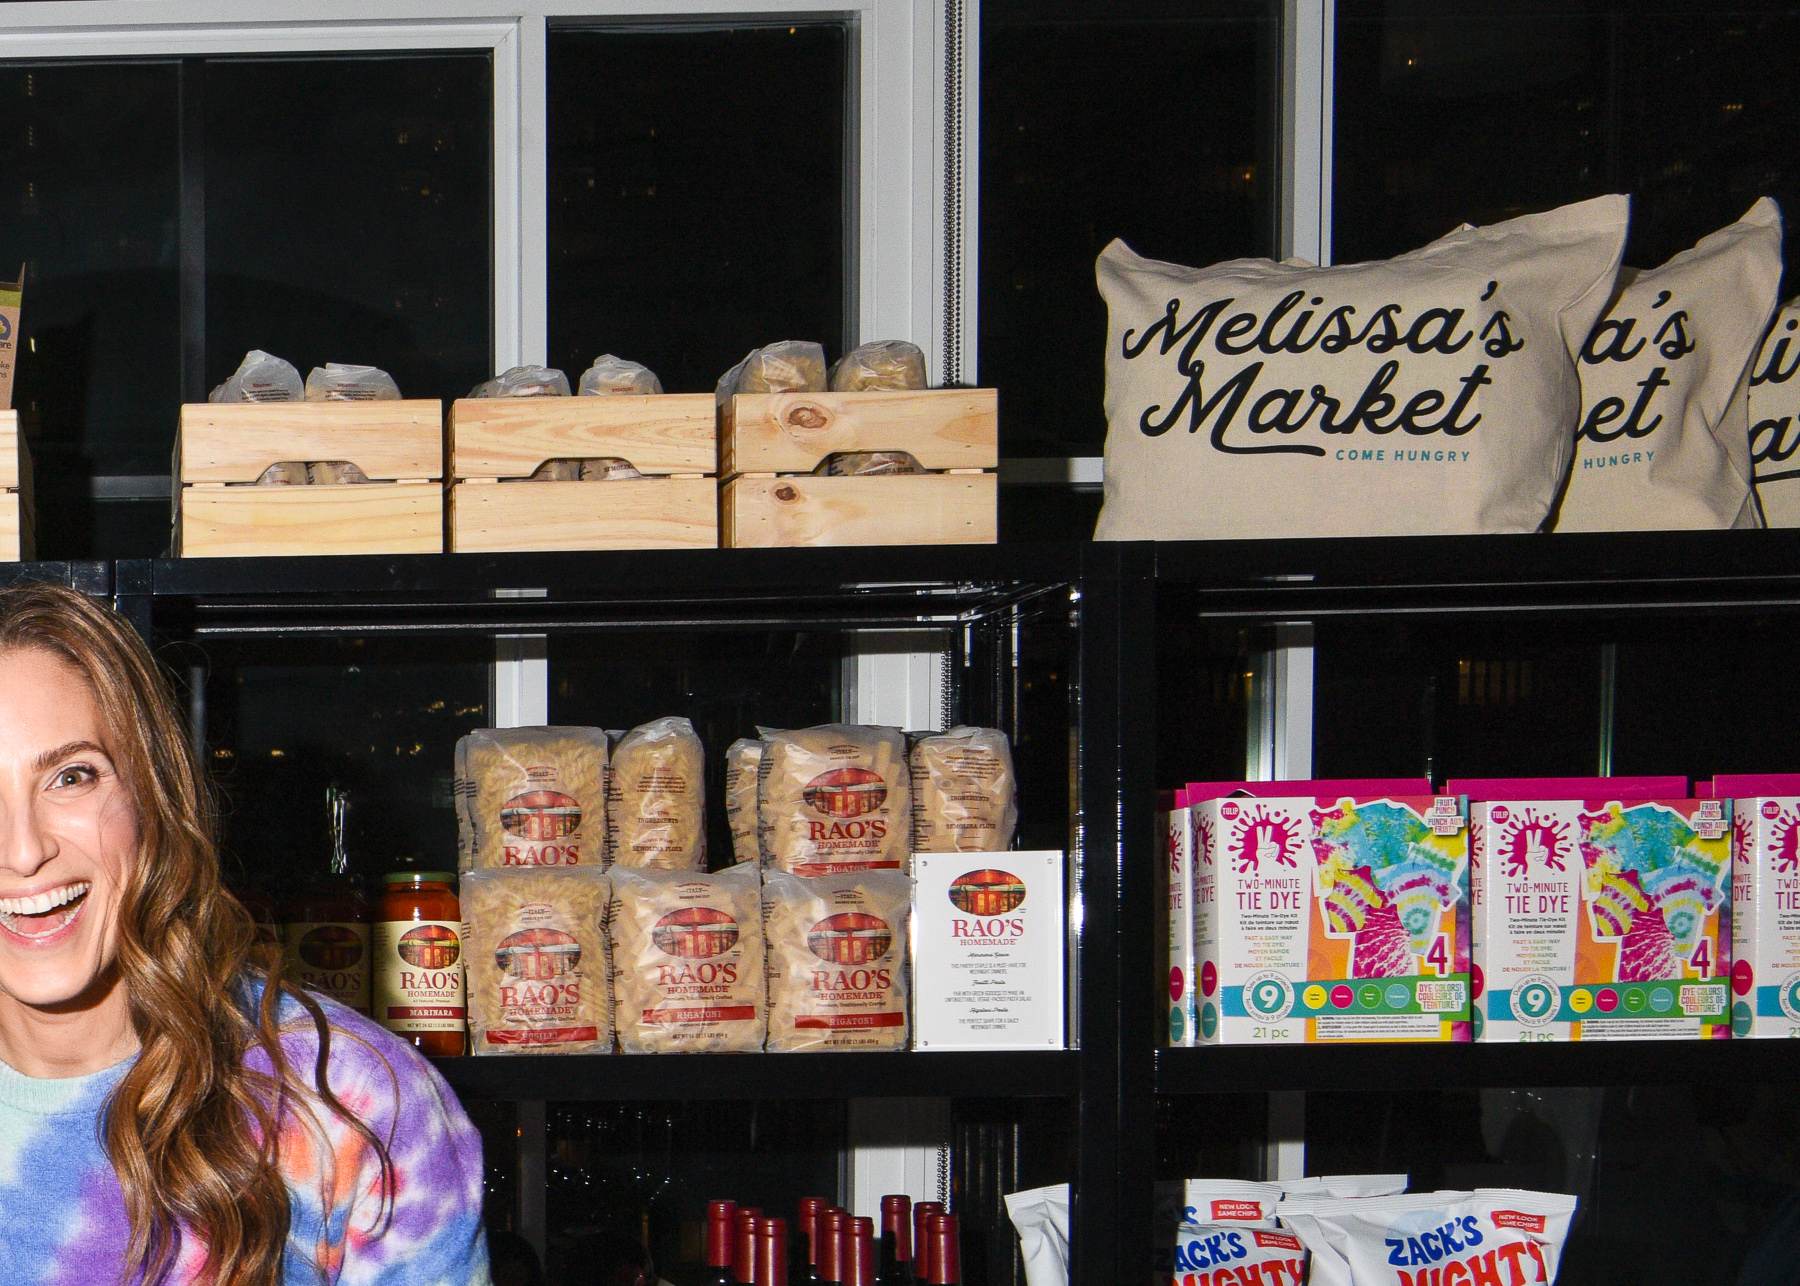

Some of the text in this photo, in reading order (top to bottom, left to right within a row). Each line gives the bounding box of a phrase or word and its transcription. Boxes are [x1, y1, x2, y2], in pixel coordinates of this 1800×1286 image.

[1121, 280, 1525, 377] Melissa's
[1139, 359, 1492, 456] Market
[1335, 450, 1471, 462] COME HUNGRY
[1583, 452, 1655, 469] HUNGRY
[1222, 807, 1238, 815] TULIP
[808, 820, 886, 841] RAO'S
[818, 841, 880, 849] HOMEMADE
[502, 845, 579, 866] RAO'S
[1237, 878, 1300, 890] TWO-MINUTE
[1506, 882, 1569, 894] TWO-MINUTE
[1236, 892, 1301, 910] TIE DYE
[1505, 895, 1569, 914] TIE DYE
[951, 918, 1024, 938] RAO'S
[1427, 935, 1448, 974] 4
[400, 972, 459, 989] RAO'S
[657, 963, 738, 985] RAO'S
[811, 969, 890, 990] RAO'S
[821, 992, 884, 1000] HOMEMADE
[1259, 985, 1279, 1008] 9
[410, 1009, 453, 1017] MARINARA
[829, 1016, 873, 1025] RIGATONI
[1253, 1026, 1289, 1040] 21 pc
[1385, 1215, 1483, 1267] ZACK'S
